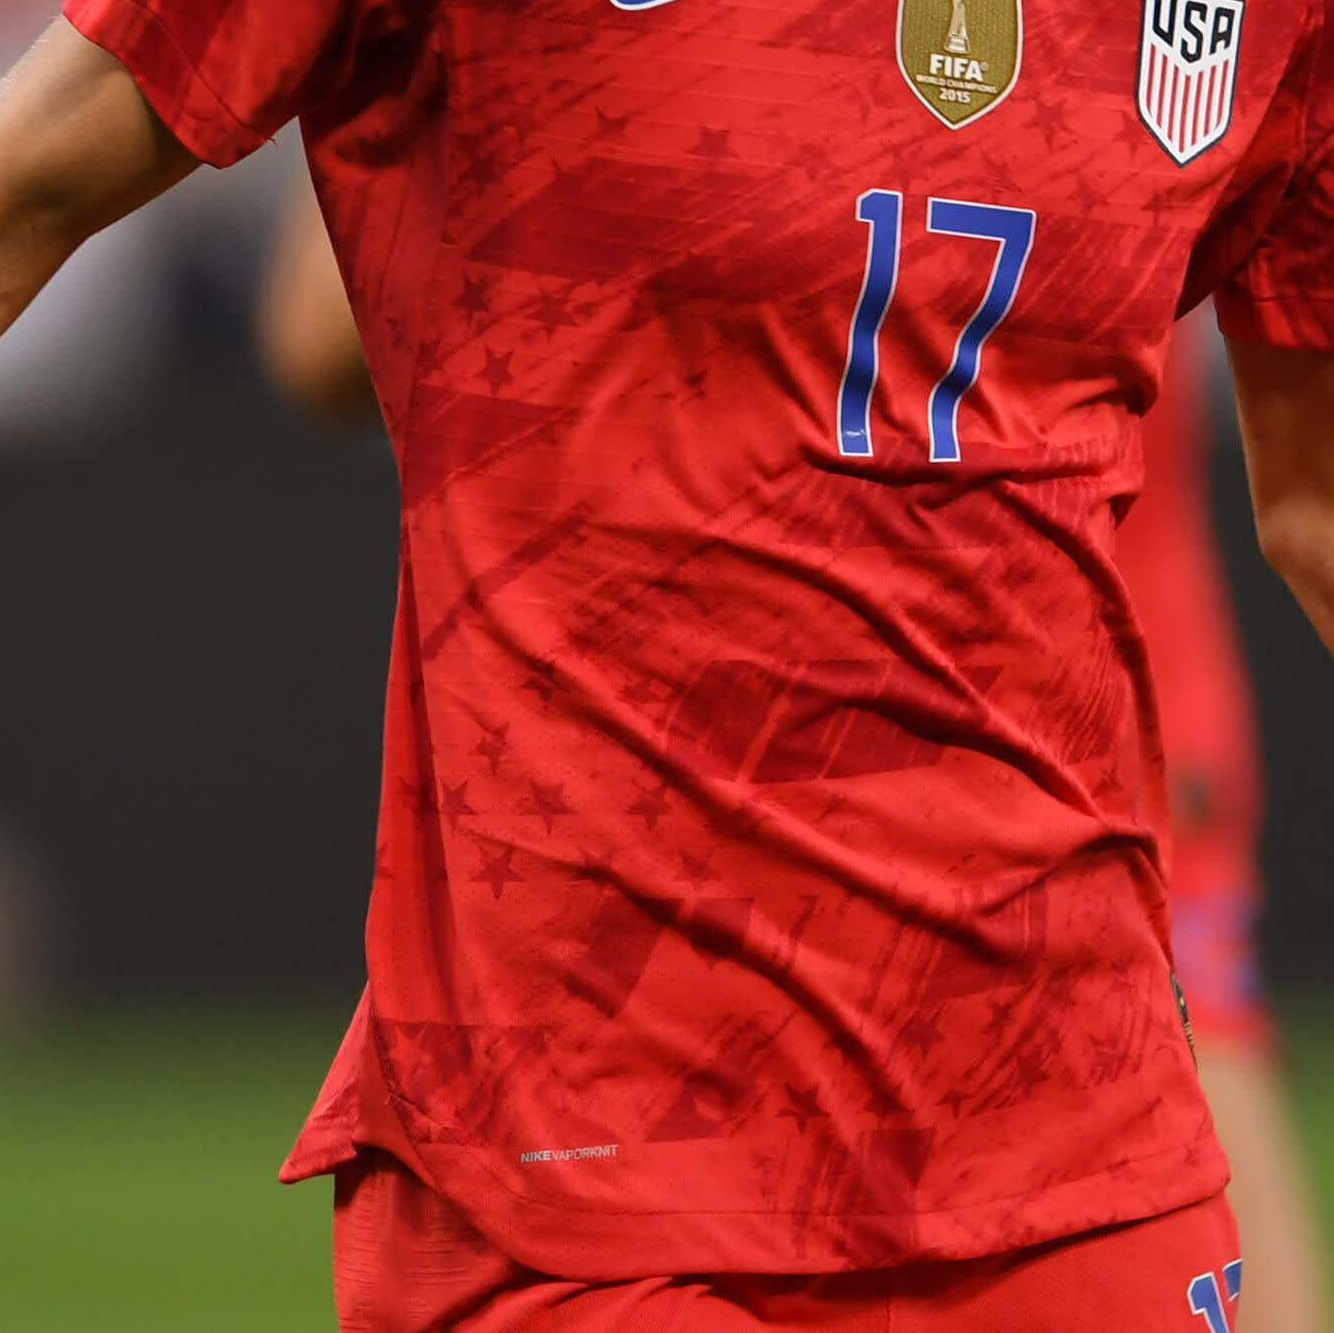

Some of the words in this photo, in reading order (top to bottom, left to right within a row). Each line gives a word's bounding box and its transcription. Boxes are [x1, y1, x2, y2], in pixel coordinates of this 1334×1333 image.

[929, 53, 984, 82] FIFA
[939, 87, 971, 103] 2015
[837, 188, 1037, 463] 17
